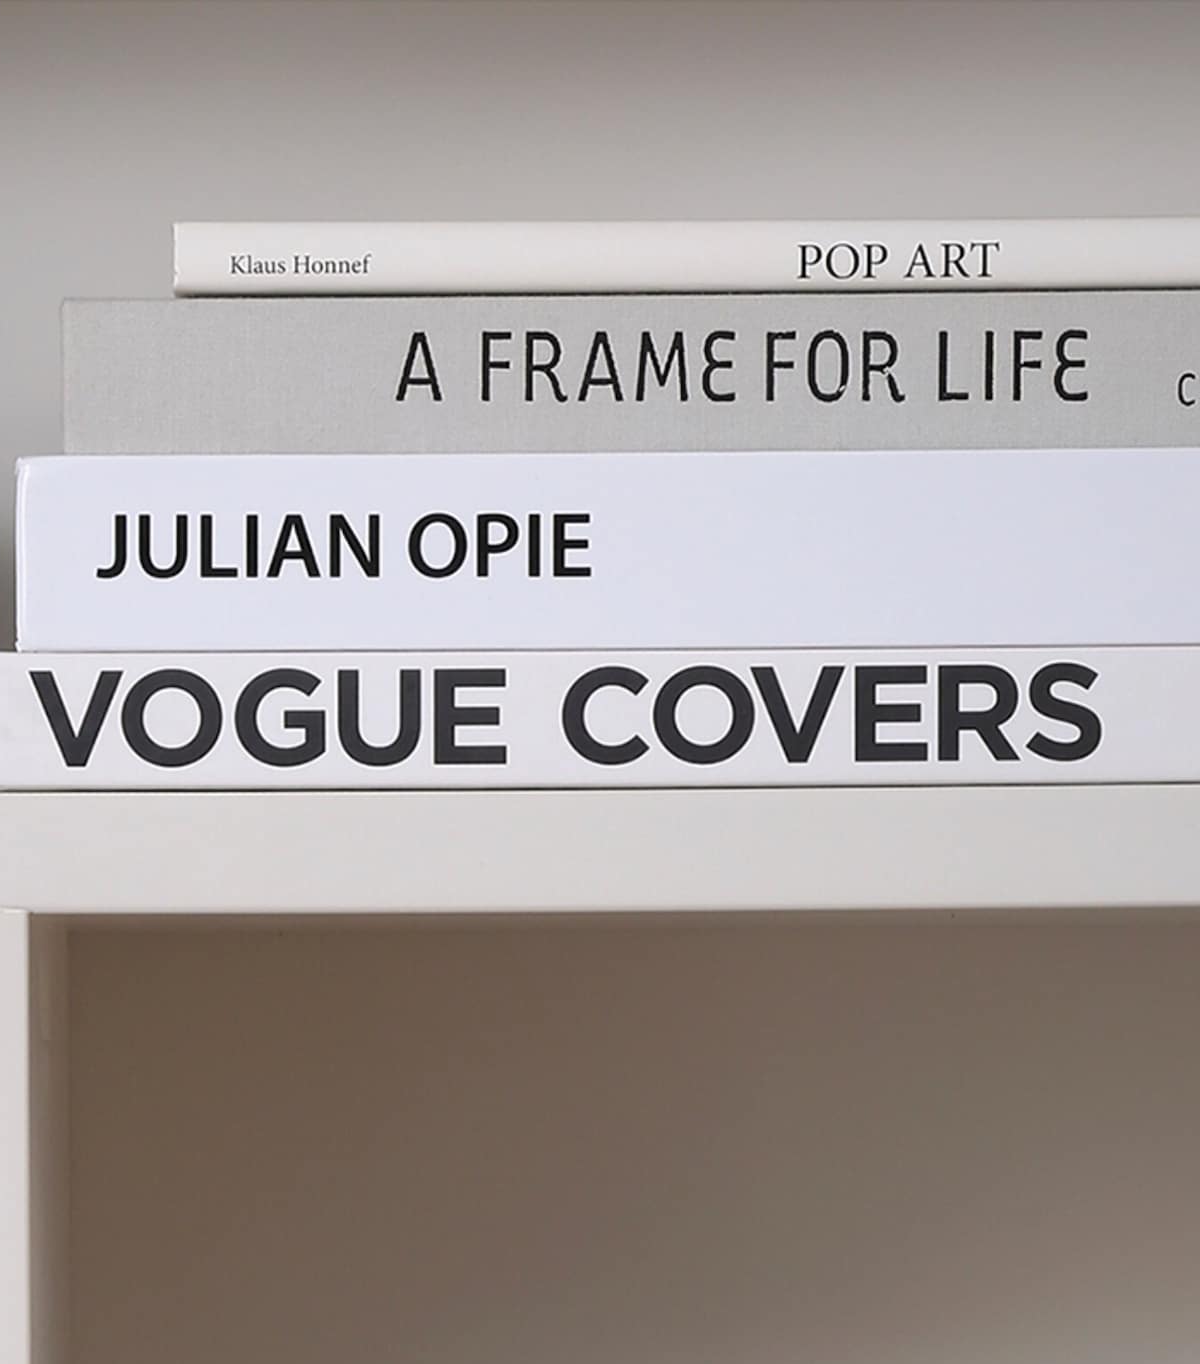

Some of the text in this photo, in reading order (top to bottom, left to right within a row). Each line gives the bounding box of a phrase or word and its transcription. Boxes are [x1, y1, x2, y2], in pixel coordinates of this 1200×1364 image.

[231, 253, 372, 275] Klaus Honnef
[798, 242, 1000, 279] POP ART
[395, 328, 1089, 404] A FRAME FOR LIFE
[96, 512, 592, 579] JULIAN OPIE
[28, 662, 1102, 768] VOGUE COVERS
